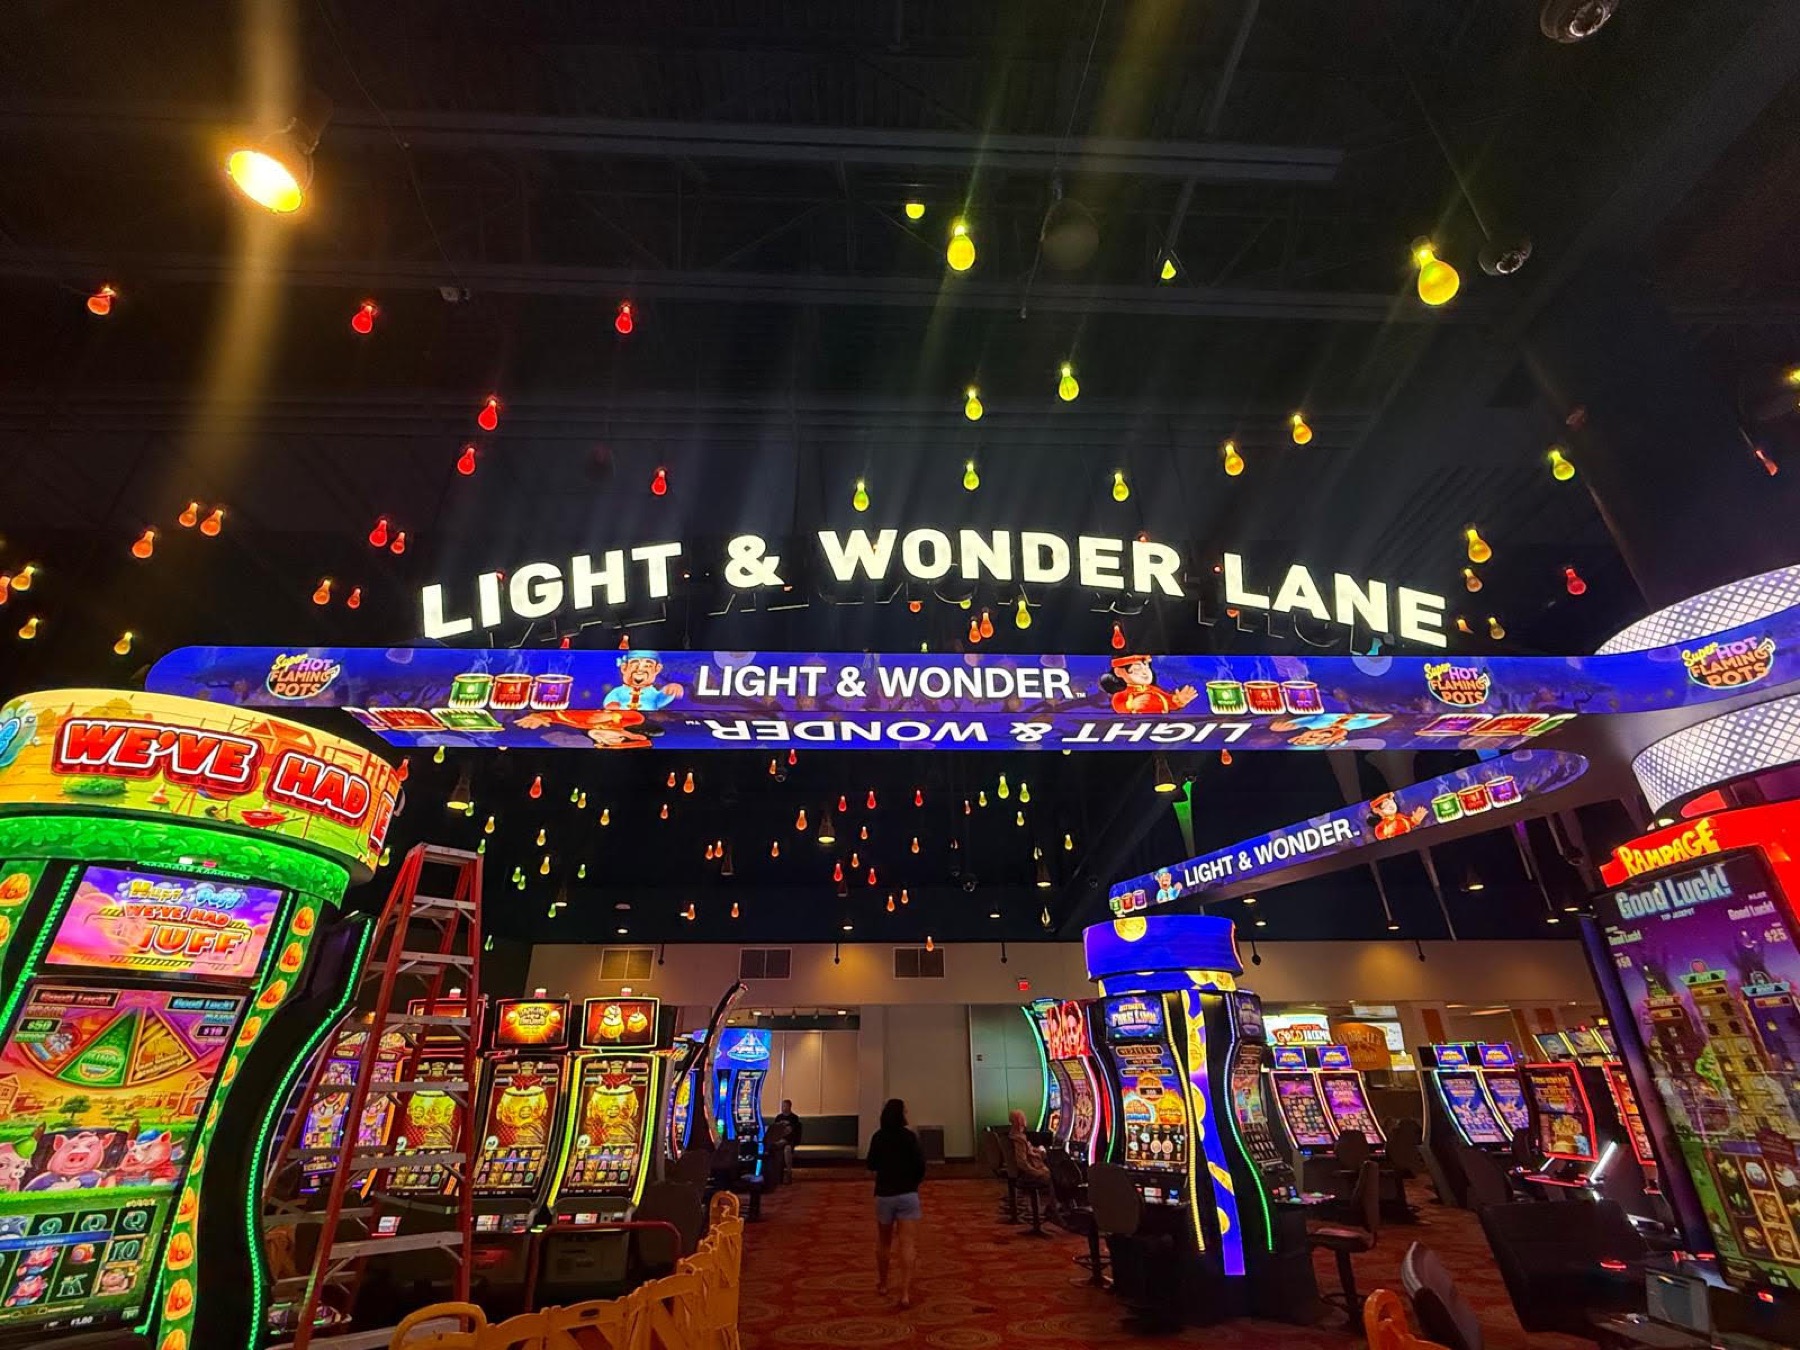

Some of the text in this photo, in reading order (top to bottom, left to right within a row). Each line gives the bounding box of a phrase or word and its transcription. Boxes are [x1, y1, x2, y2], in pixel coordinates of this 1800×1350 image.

[422, 528, 1448, 648] LIGHT & WONDER LANE
[1681, 636, 1758, 667] Super HOT
[1689, 648, 1769, 678] FLAMING
[270, 669, 331, 683] FLAMING
[298, 658, 334, 672] HOT
[1449, 666, 1478, 681] HOT
[1706, 662, 1769, 689] POTS
[274, 682, 321, 697] POTS
[698, 665, 827, 698] LIGHT
[836, 666, 867, 698] &
[1430, 679, 1486, 691] FLAMING
[1441, 691, 1485, 704] POTS
[1010, 721, 1053, 742] &
[1062, 722, 1252, 743] LIGHT
[64, 720, 258, 783] WE'VE
[275, 751, 371, 818] HAD
[1617, 816, 1722, 878] RAMPAGE
[1184, 854, 1234, 888] LIGHT
[1238, 850, 1253, 871] &
[1615, 863, 1734, 920] Good Luck!
[125, 903, 232, 928] WE'VE HAD
[1763, 927, 1789, 944] $25
